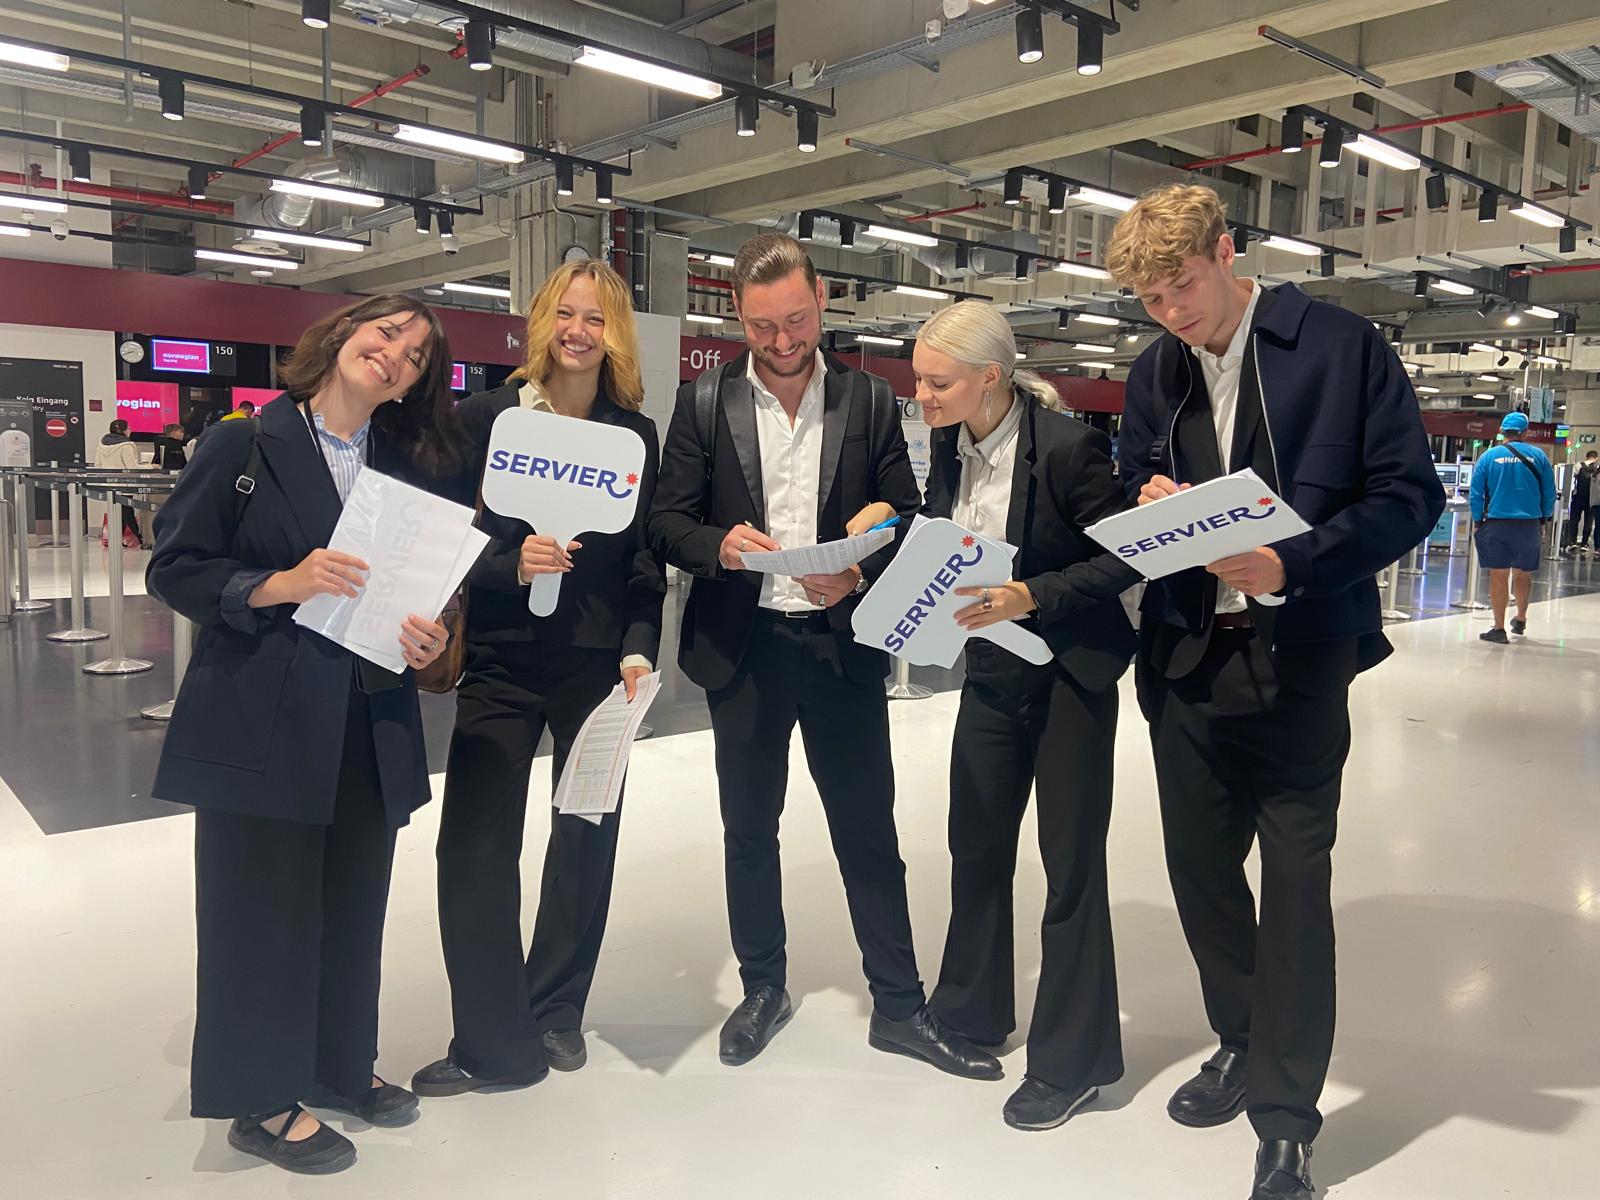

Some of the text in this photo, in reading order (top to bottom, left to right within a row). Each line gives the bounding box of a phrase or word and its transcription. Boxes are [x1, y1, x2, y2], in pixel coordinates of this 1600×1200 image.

[215, 345, 233, 356] 150
[470, 366, 483, 375] 152
[36, 396, 69, 406] Eingang
[489, 449, 633, 499] SERVIER
[1117, 505, 1276, 559] SERVIER
[884, 544, 984, 653] SERVIER
